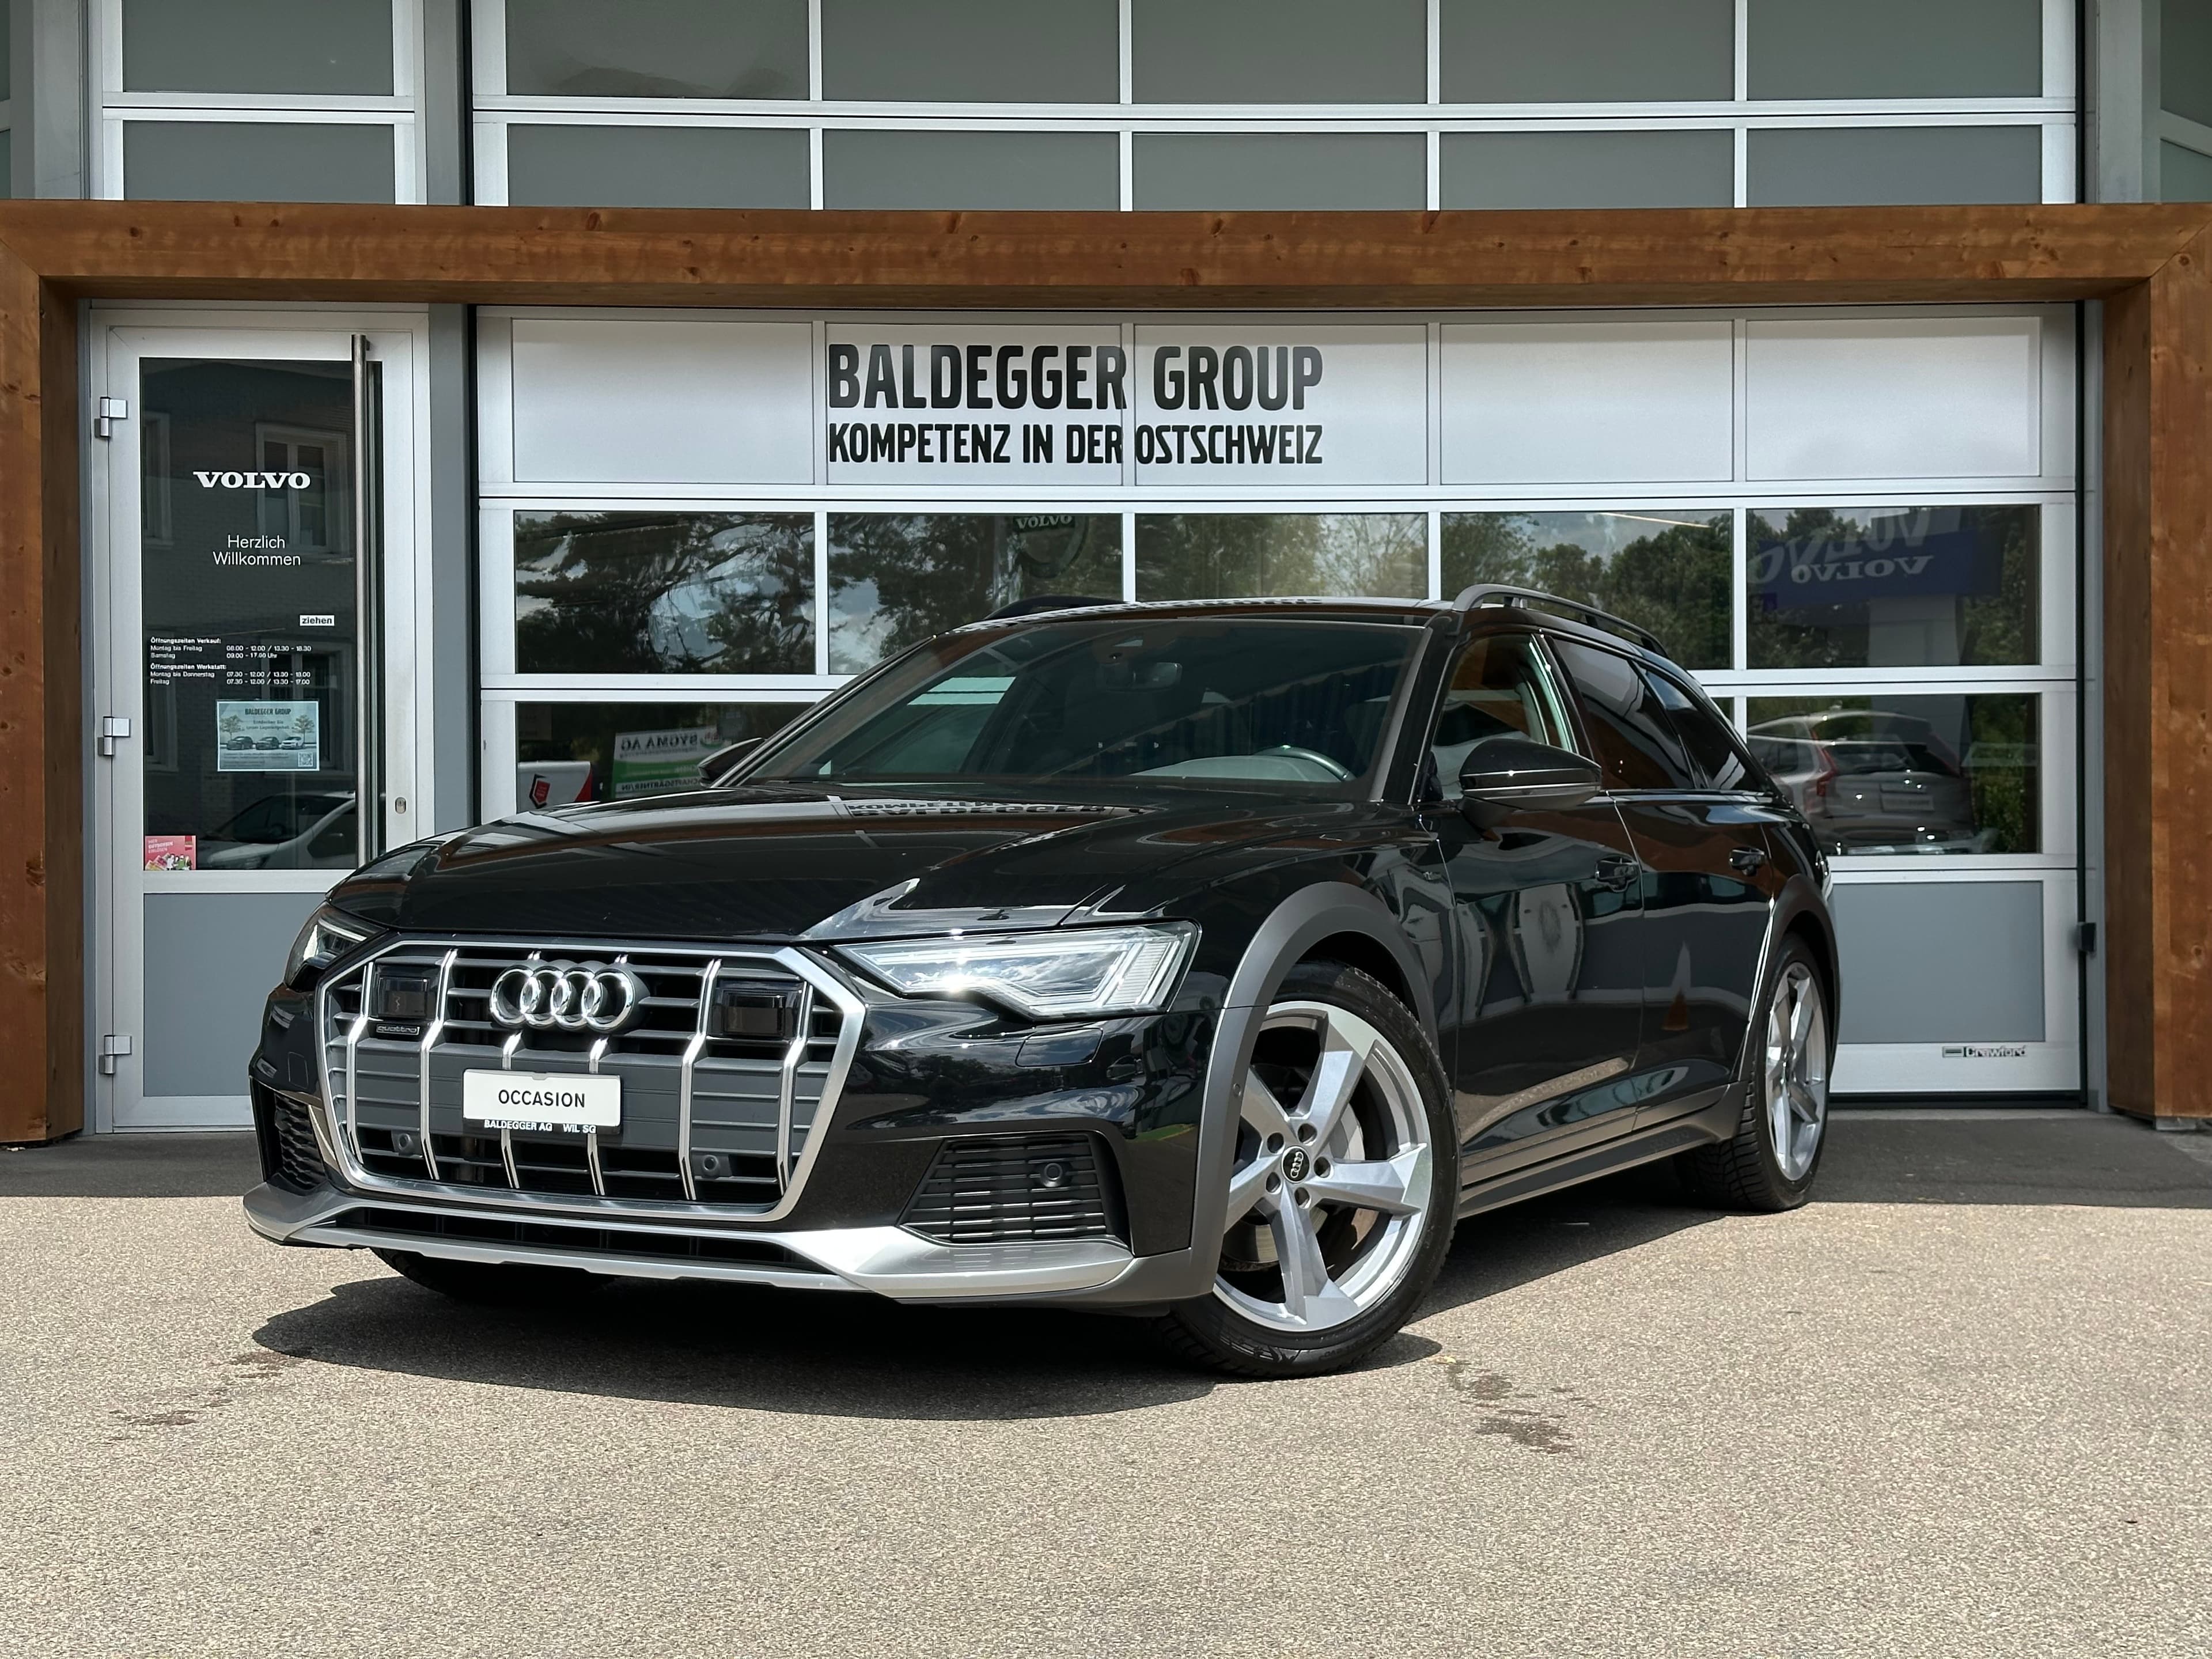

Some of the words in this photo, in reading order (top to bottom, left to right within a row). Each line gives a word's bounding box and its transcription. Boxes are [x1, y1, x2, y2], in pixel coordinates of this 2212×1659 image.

[829, 344, 1127, 410] BALDEGGER
[1153, 345, 1323, 411] GROUP
[830, 423, 1010, 463] KOMPETENZ
[1023, 424, 1053, 464] IN
[1072, 424, 1123, 464] DER
[1135, 424, 1323, 464] OSTSCHWEIZ
[193, 472, 311, 489] VOLVO
[1016, 514, 1073, 529] VOLVO
[228, 535, 285, 548] Herzlich
[213, 551, 301, 565] Willkommen
[1964, 1045, 2027, 1057] Crawford
[498, 1089, 585, 1108] OCCASION
[484, 1119, 537, 1131] BALDEGGER
[539, 1123, 553, 1132] AG
[563, 1123, 580, 1134] WIL
[582, 1124, 596, 1134] SG
